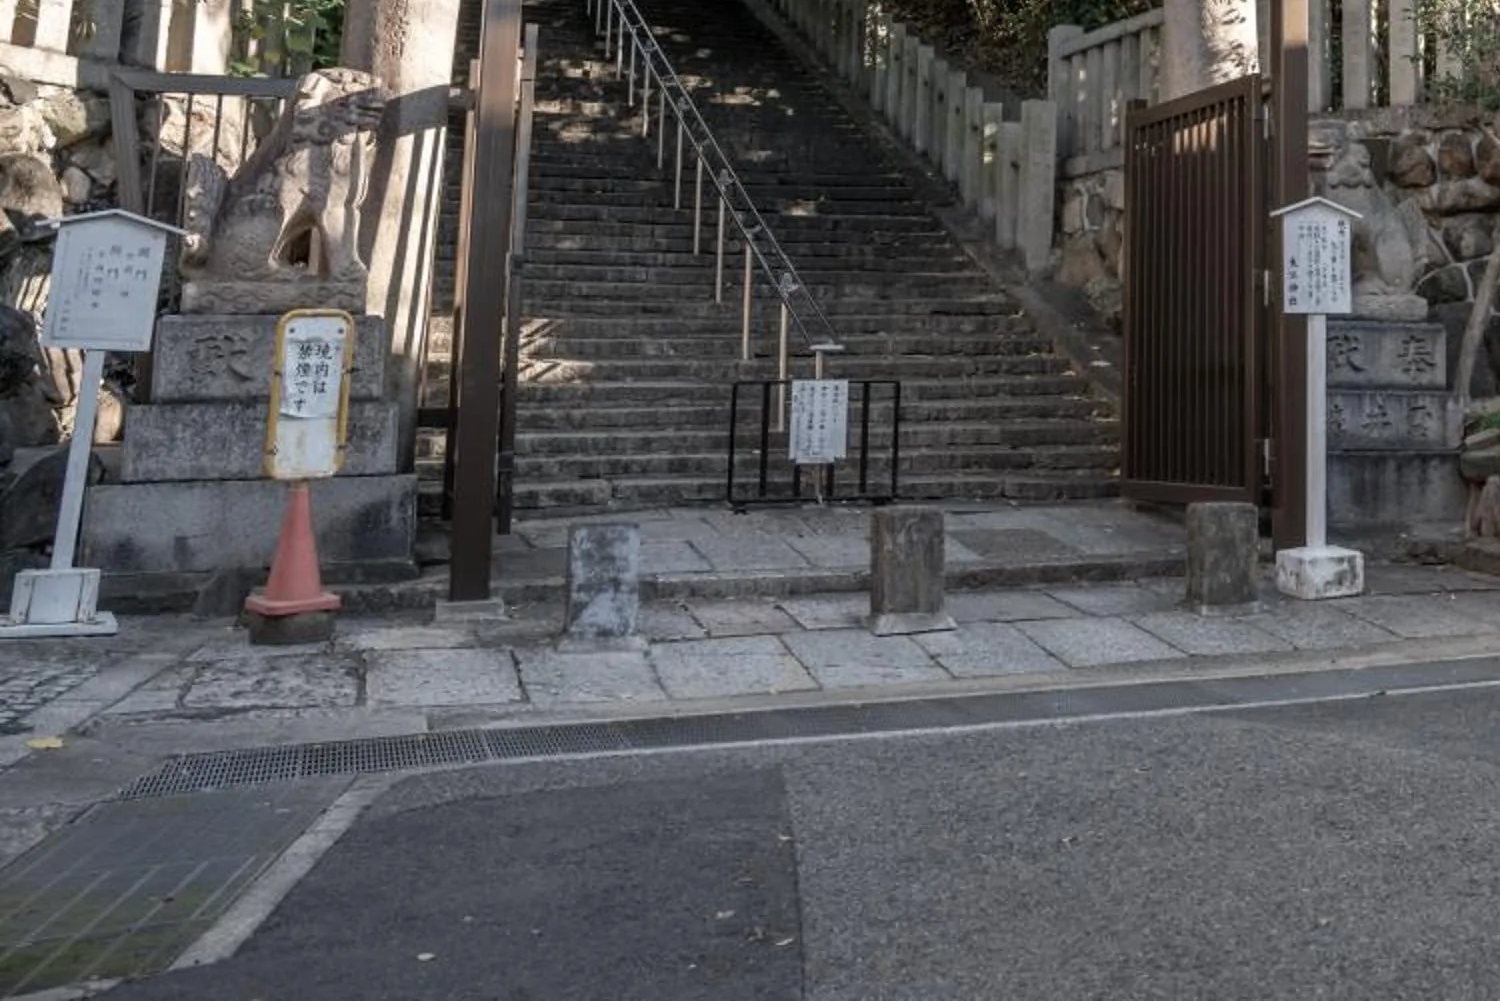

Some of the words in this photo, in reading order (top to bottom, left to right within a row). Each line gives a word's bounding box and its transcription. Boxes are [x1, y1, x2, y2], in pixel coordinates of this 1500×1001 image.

[294, 344, 312, 412] 禁煙です
[313, 343, 333, 394] 境内は
